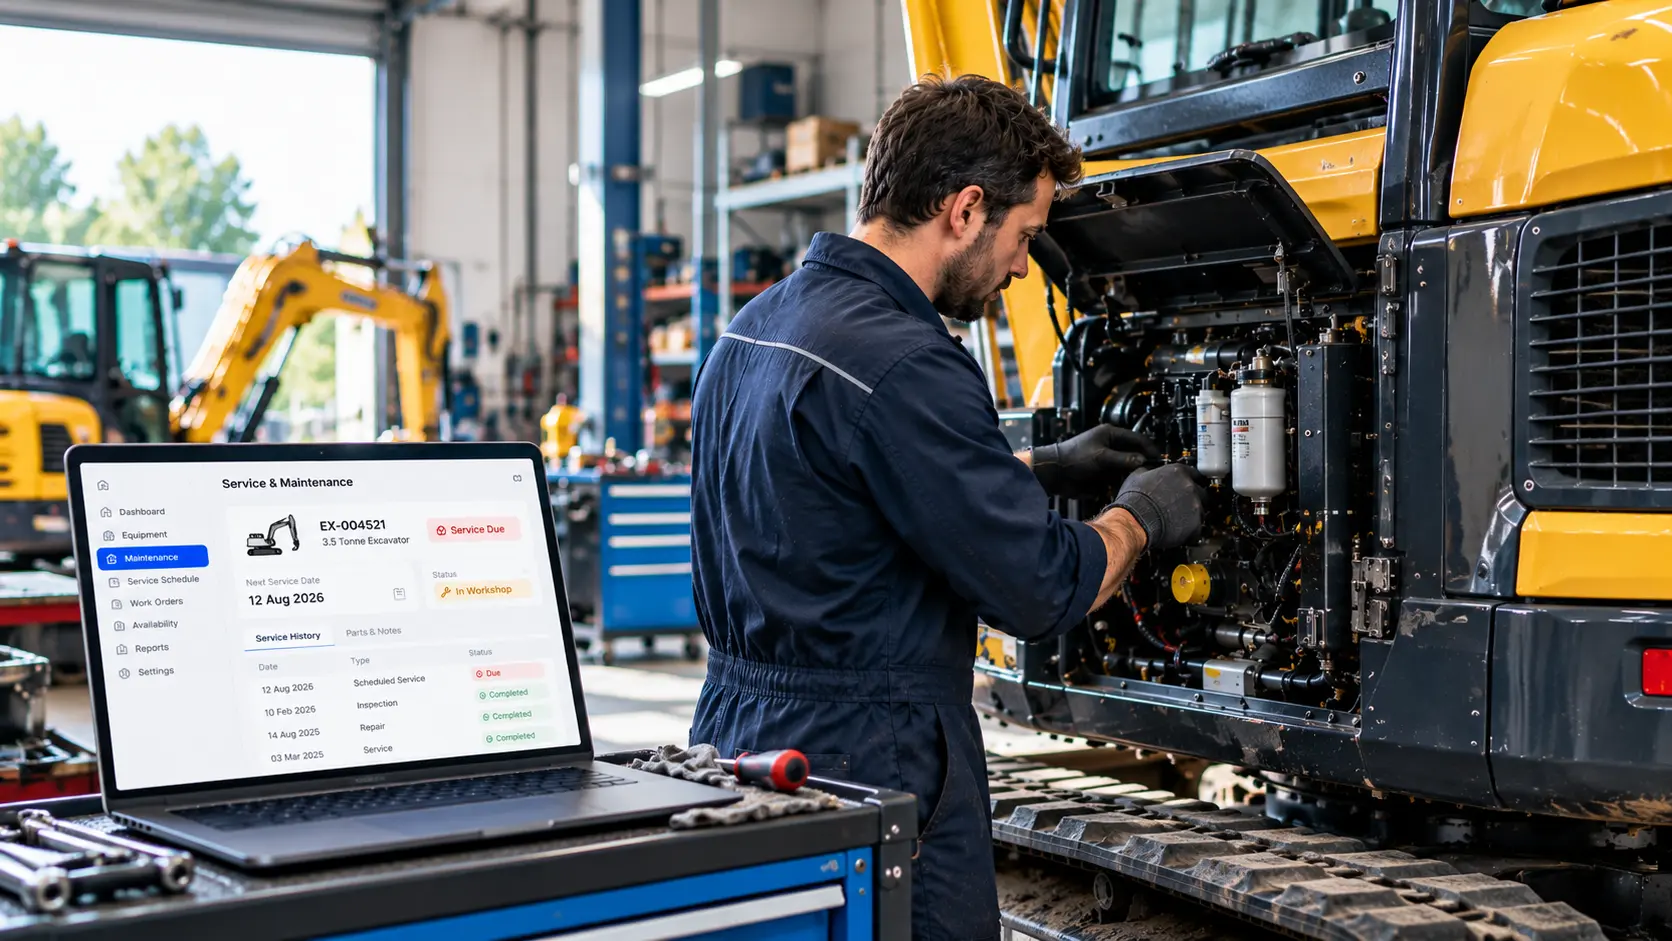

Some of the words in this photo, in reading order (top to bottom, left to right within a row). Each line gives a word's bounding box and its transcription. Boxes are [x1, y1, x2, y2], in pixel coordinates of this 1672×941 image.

[222, 478, 267, 489] Service
[269, 477, 278, 489] &
[279, 477, 354, 488] Maintenance
[119, 507, 166, 516] Dashboard
[319, 519, 386, 532] EX-004521
[450, 525, 485, 535] Service
[486, 524, 505, 534] Due
[121, 530, 168, 541] Equipment
[322, 537, 337, 547] 3.5
[339, 536, 366, 546] Tonne
[367, 536, 410, 545] Excavator
[124, 554, 179, 563] Maintenance
[127, 576, 159, 586] Service
[161, 574, 200, 584] Schedule
[432, 571, 458, 579] Status
[267, 577, 299, 586] Service
[300, 576, 321, 585] Date
[455, 587, 465, 596] In
[465, 585, 513, 596] Workshop
[129, 599, 152, 608] Work
[154, 597, 184, 607] Orders
[248, 594, 263, 606] 12
[265, 594, 291, 607] Aug
[292, 592, 325, 604] 2026
[132, 619, 179, 629] Availability
[255, 633, 288, 643] Service
[289, 632, 321, 641] History
[345, 629, 368, 637] Parts
[369, 627, 377, 636] &
[377, 627, 402, 636] Notes
[134, 643, 170, 654] Reports
[468, 649, 493, 657] Status
[350, 656, 370, 666] Type
[138, 667, 175, 677] Settings
[258, 663, 278, 672] Date
[486, 669, 501, 678] Due
[353, 676, 396, 688] Scheduled
[397, 674, 426, 684] Service
[262, 685, 272, 695] 12
[274, 685, 291, 695] Aug
[292, 682, 314, 692] 2026
[488, 688, 529, 699] Completed
[356, 699, 398, 710] Inspection
[264, 708, 275, 717] 10
[276, 707, 293, 716] Feb
[294, 705, 316, 715] 2026
[492, 710, 533, 721] Completed
[359, 722, 386, 733] Repair
[268, 731, 279, 740] 14
[280, 730, 297, 740] Aug
[298, 727, 321, 738] 2025
[495, 731, 536, 743] Completed
[363, 744, 393, 755] Service
[270, 753, 283, 763] 03
[284, 753, 300, 761] Mar
[302, 750, 325, 760] 2025
